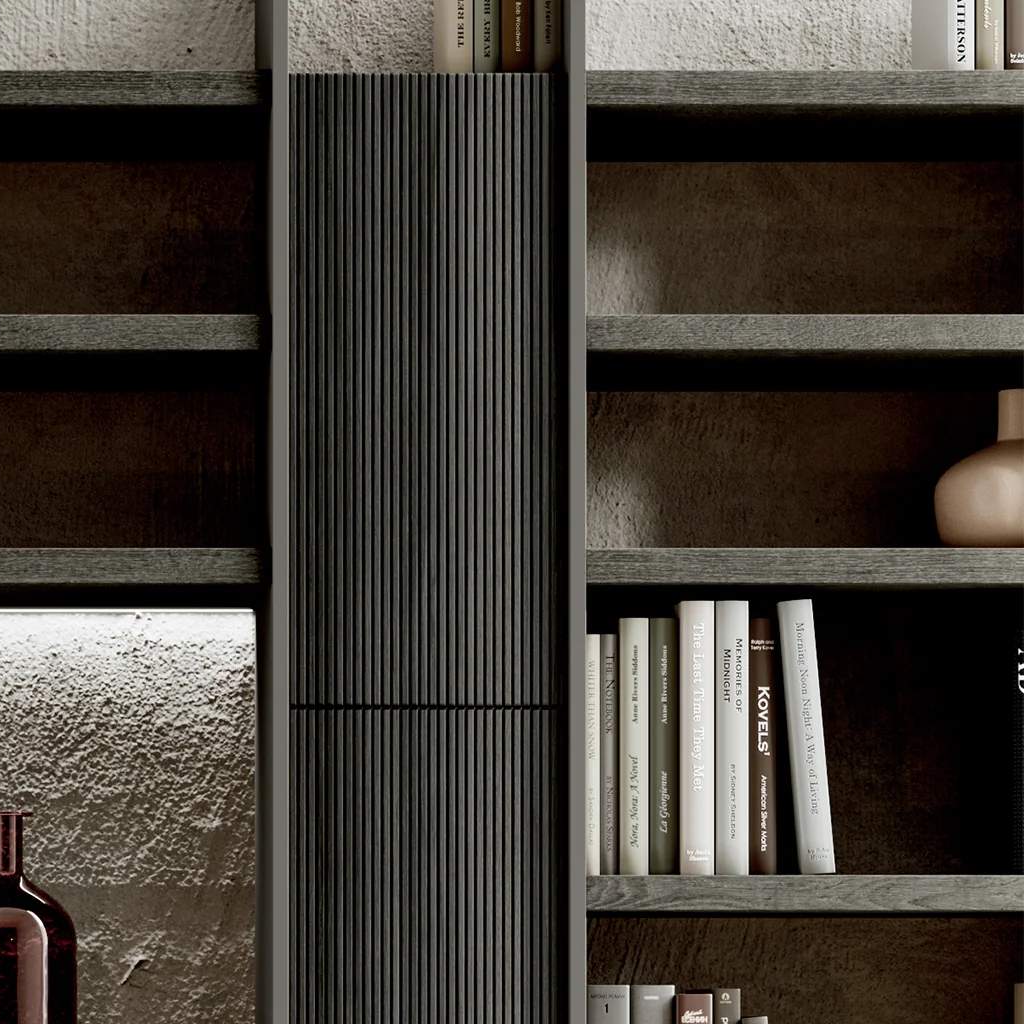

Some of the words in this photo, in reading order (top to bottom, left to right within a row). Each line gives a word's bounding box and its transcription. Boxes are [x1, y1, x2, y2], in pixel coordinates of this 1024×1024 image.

[692, 622, 705, 649] The
[796, 622, 806, 666] Morning
[692, 654, 705, 684] Last
[799, 669, 808, 695] Noon
[692, 688, 705, 723] Time
[736, 700, 742, 712] OF
[800, 698, 813, 731] Night:
[690, 727, 705, 761] They
[805, 733, 814, 742] A
[806, 744, 816, 765] Way
[629, 754, 639, 783] Novel
[692, 765, 705, 791] Met
[809, 768, 818, 779] of
[809, 782, 819, 814] Living
[660, 821, 668, 833] La
[604, 1004, 608, 1013] 1
